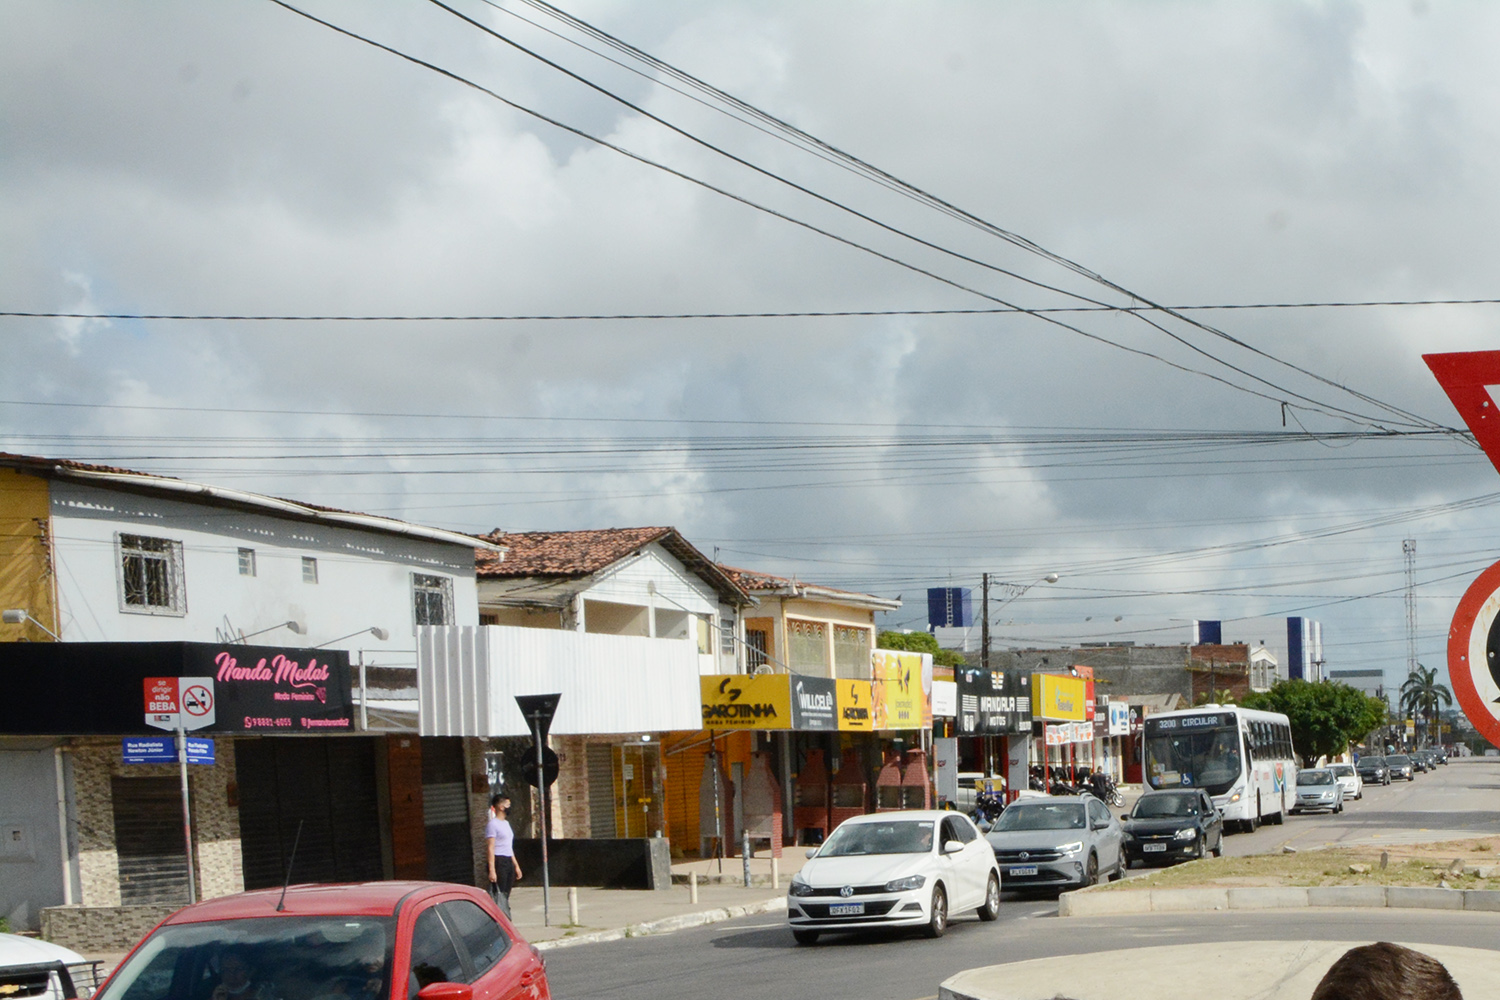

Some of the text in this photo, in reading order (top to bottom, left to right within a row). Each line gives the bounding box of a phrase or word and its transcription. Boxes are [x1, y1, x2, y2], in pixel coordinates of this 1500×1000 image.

[215, 651, 329, 688] Nanda Modas
[149, 702, 176, 711] BEBA
[981, 697, 1015, 712] MANDALA
[1159, 716, 1218, 729] 3200 CIRCULAR
